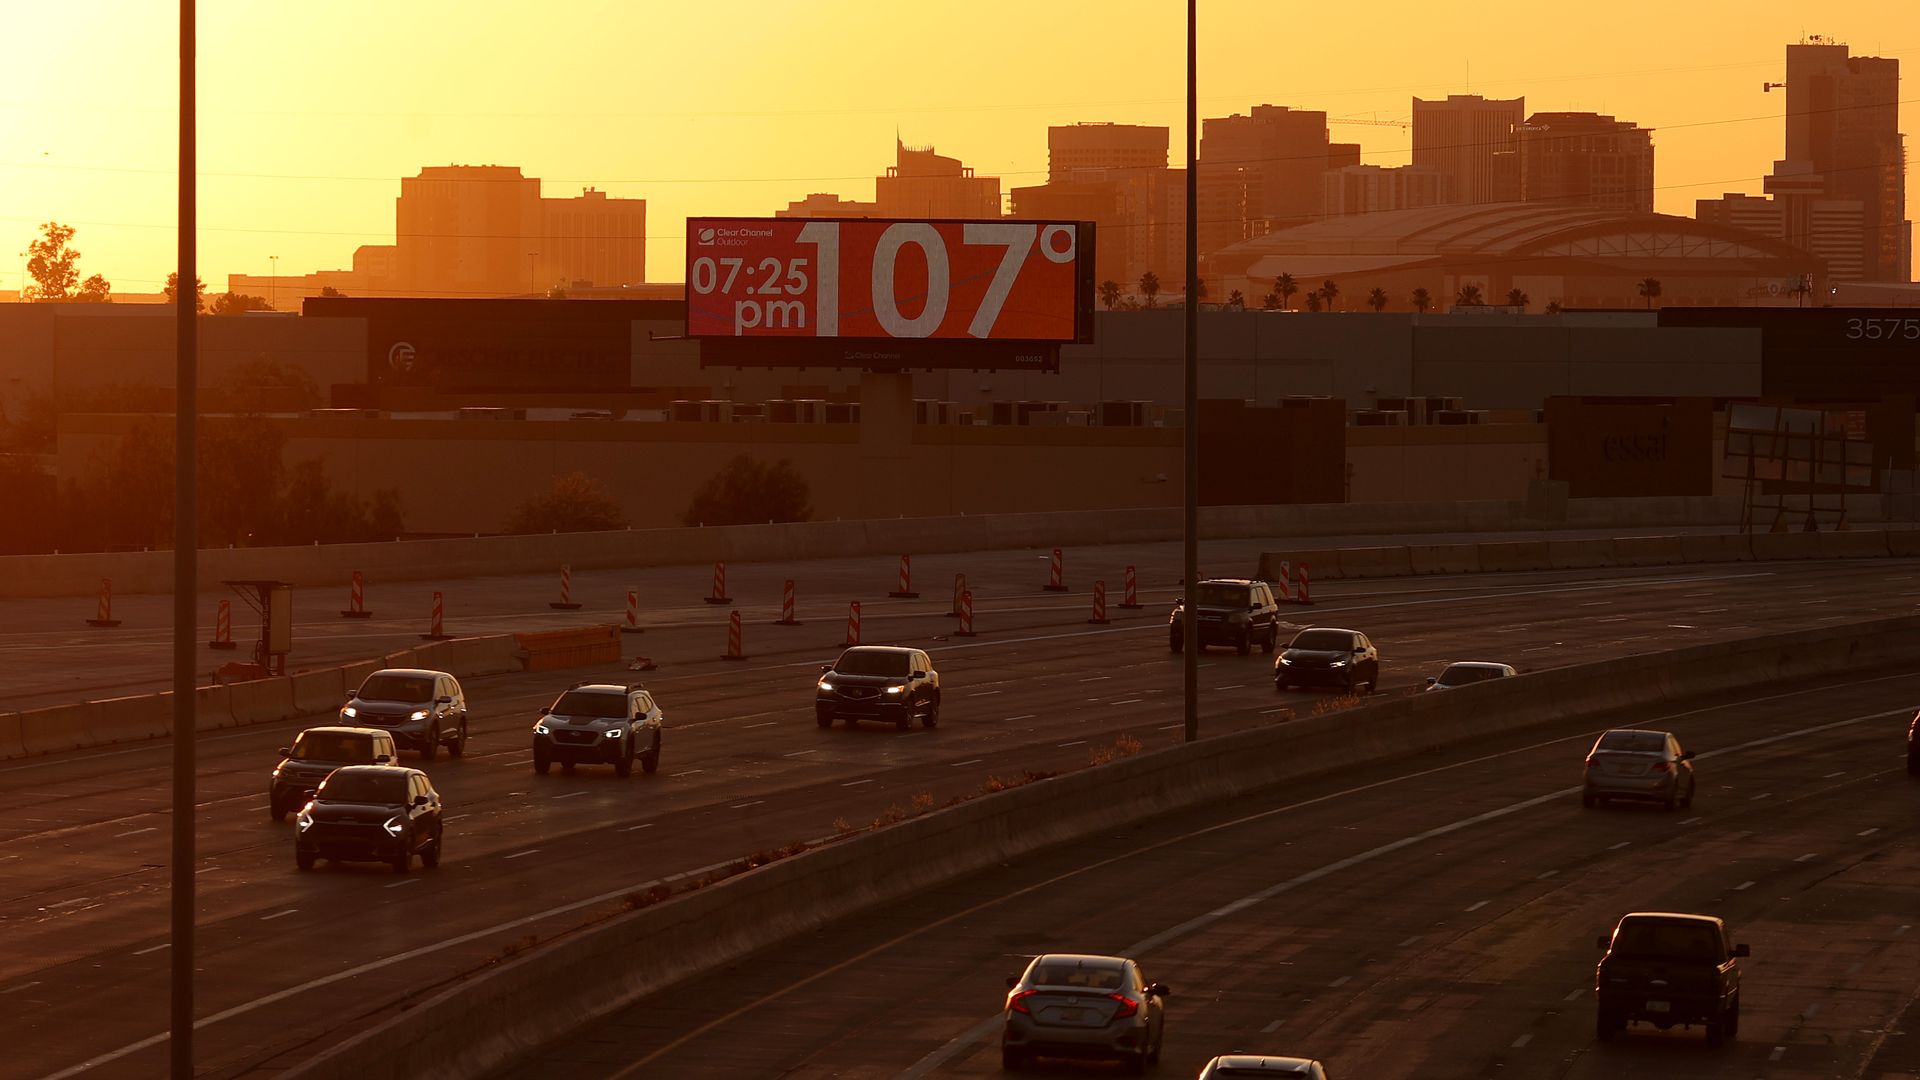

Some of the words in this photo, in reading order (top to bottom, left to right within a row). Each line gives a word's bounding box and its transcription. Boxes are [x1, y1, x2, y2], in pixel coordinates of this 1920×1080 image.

[717, 228, 738, 237] Clear
[739, 228, 773, 237] Channel
[717, 238, 748, 246] Outdoor
[692, 256, 808, 295] 07:25
[735, 300, 806, 336] pm
[1846, 318, 1920, 339] 3575
